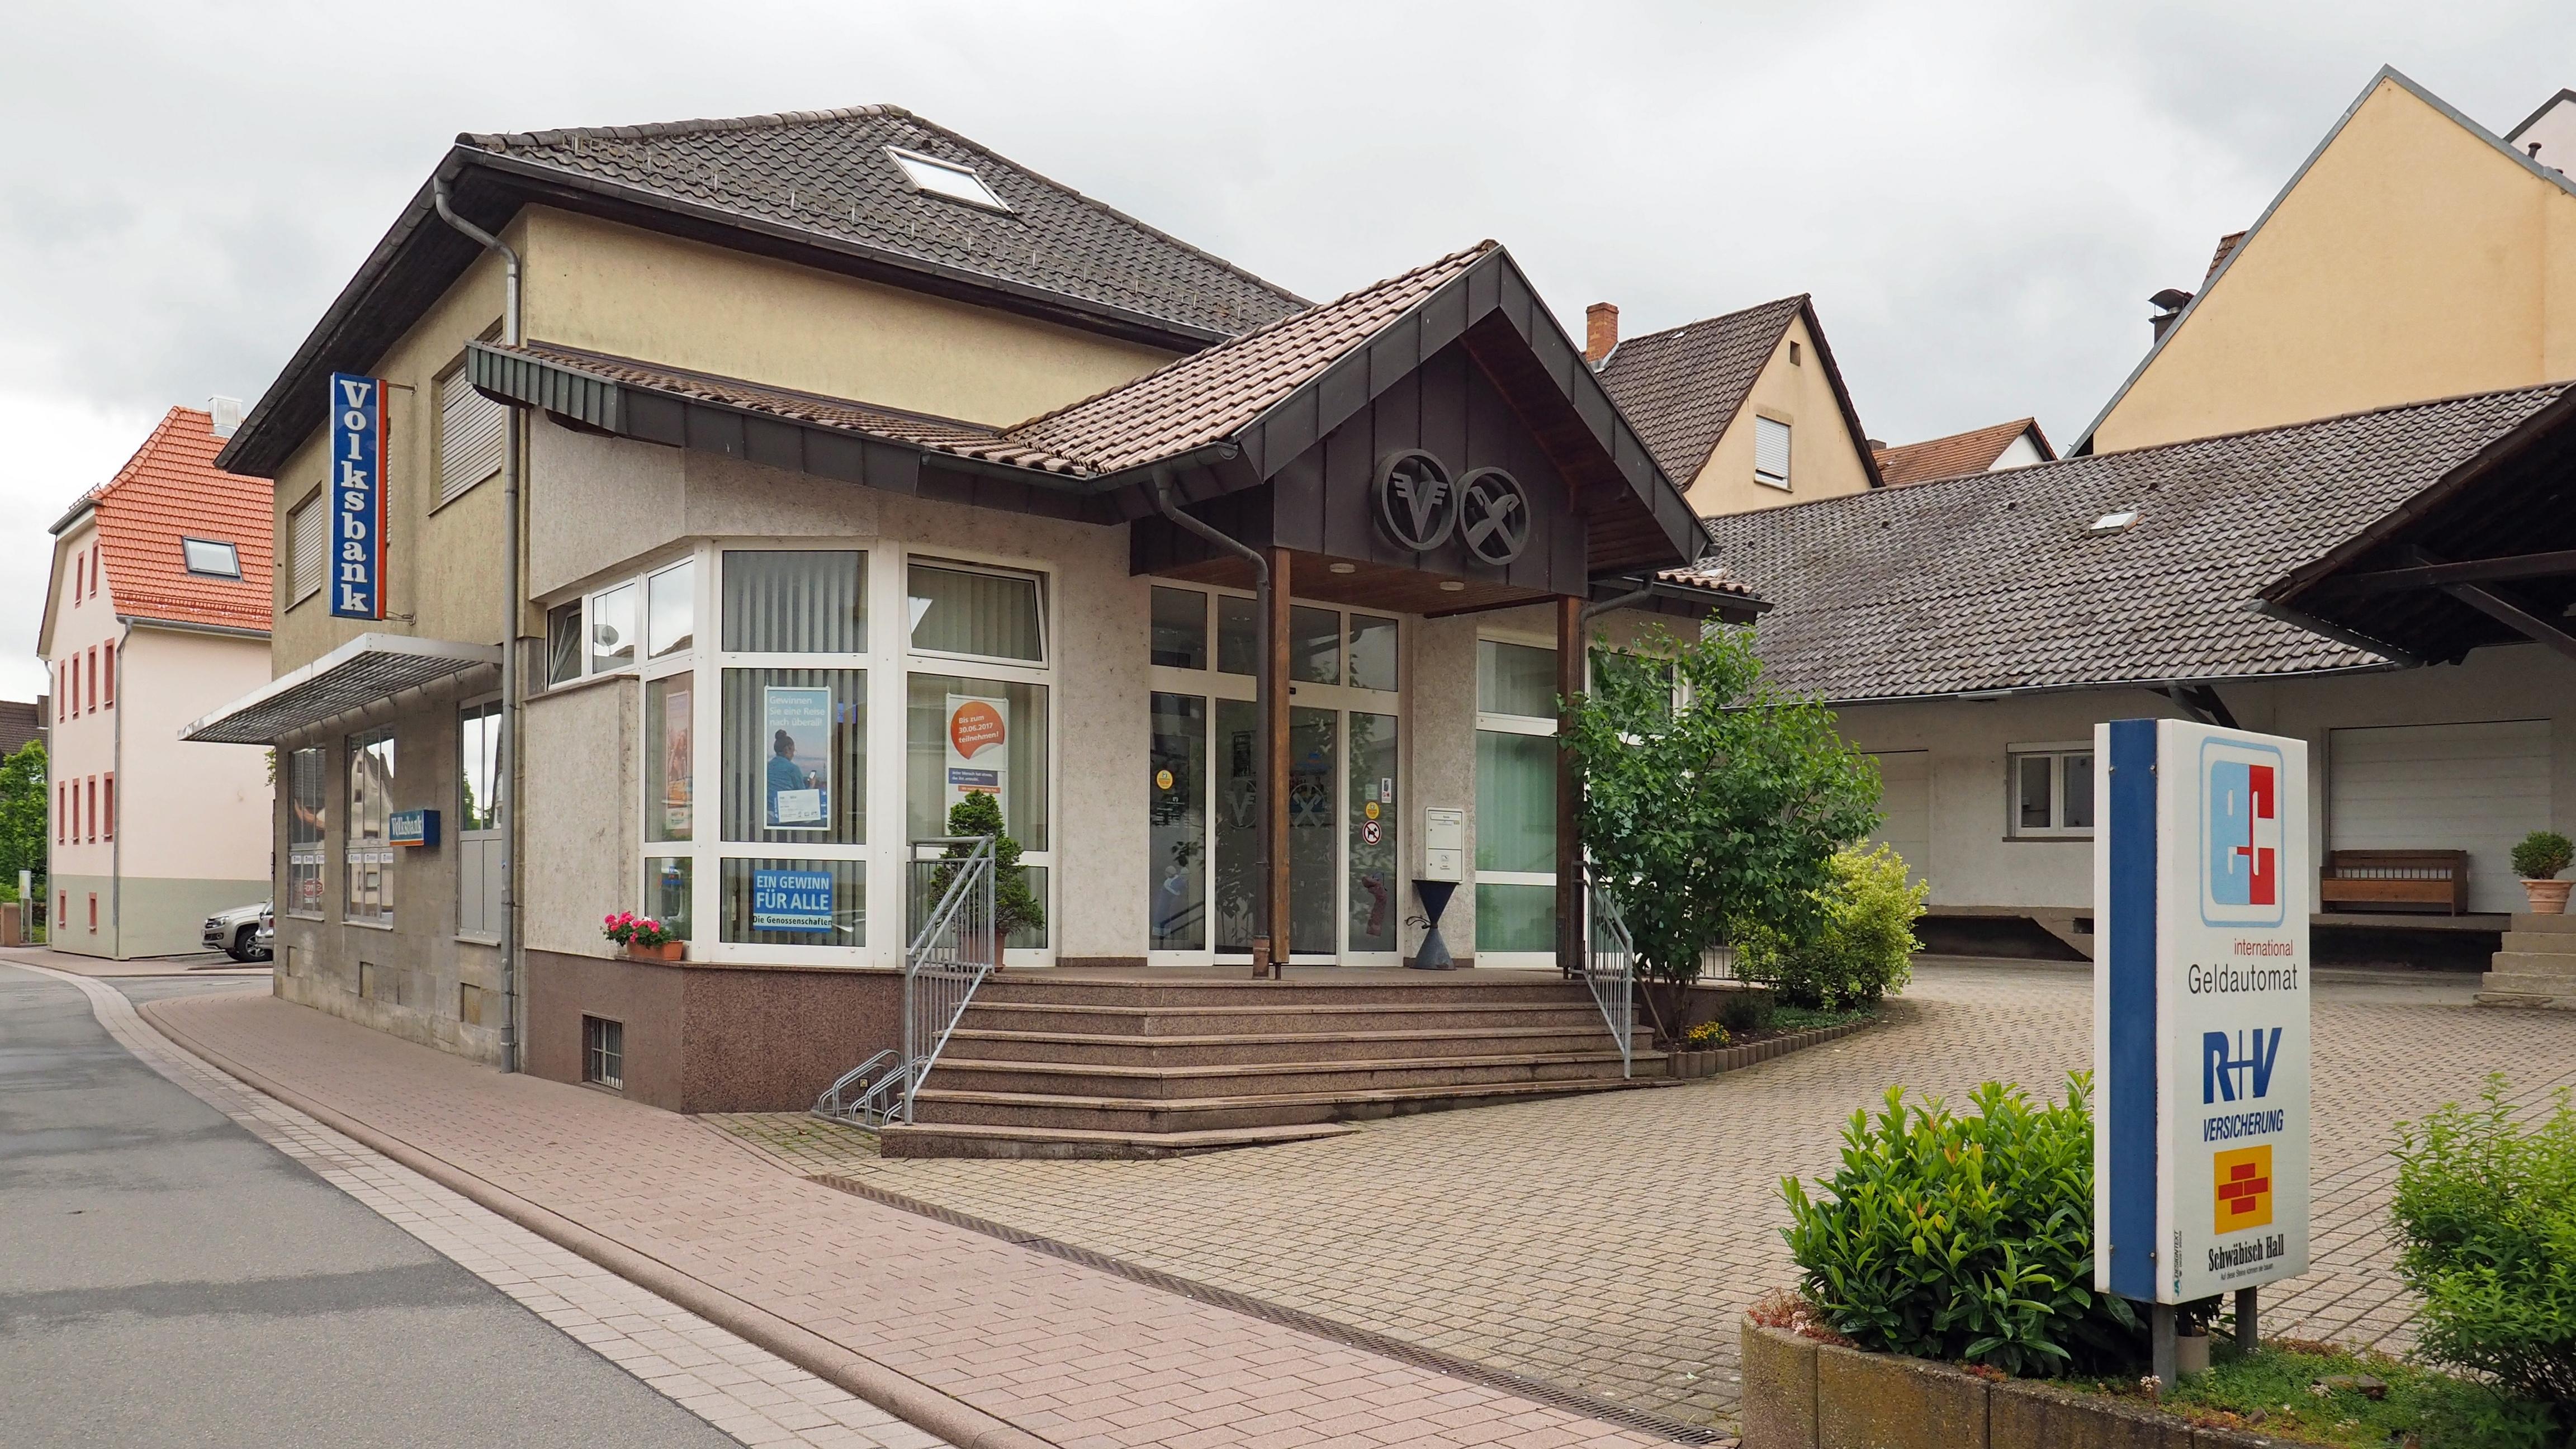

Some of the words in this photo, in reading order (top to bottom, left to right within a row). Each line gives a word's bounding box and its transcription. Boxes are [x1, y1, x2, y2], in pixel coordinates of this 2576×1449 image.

[340, 380, 371, 612] Volksbank
[770, 696, 812, 704] Gewinnen
[803, 707, 825, 716] Reise
[769, 718, 789, 726] nach
[792, 717, 822, 726] überall!
[959, 722, 993, 733] 30.06.2017
[959, 731, 999, 743] teilnehmen!
[391, 815, 422, 836] Volksbank
[756, 875, 776, 888] EIN
[780, 877, 829, 890] GEWINN
[756, 889, 787, 908] FÜR
[790, 893, 829, 910] ALLE
[766, 916, 832, 926] Genossenschaften
[2234, 938, 2293, 956] international
[2188, 963, 2298, 995] Geldautomat
[2203, 1027, 2283, 1105] R+V
[2203, 1109, 2284, 1142] VERSICHERUNG
[2208, 1238, 2264, 1272] Schwäbisch
[2266, 1233, 2284, 1258] Hall
